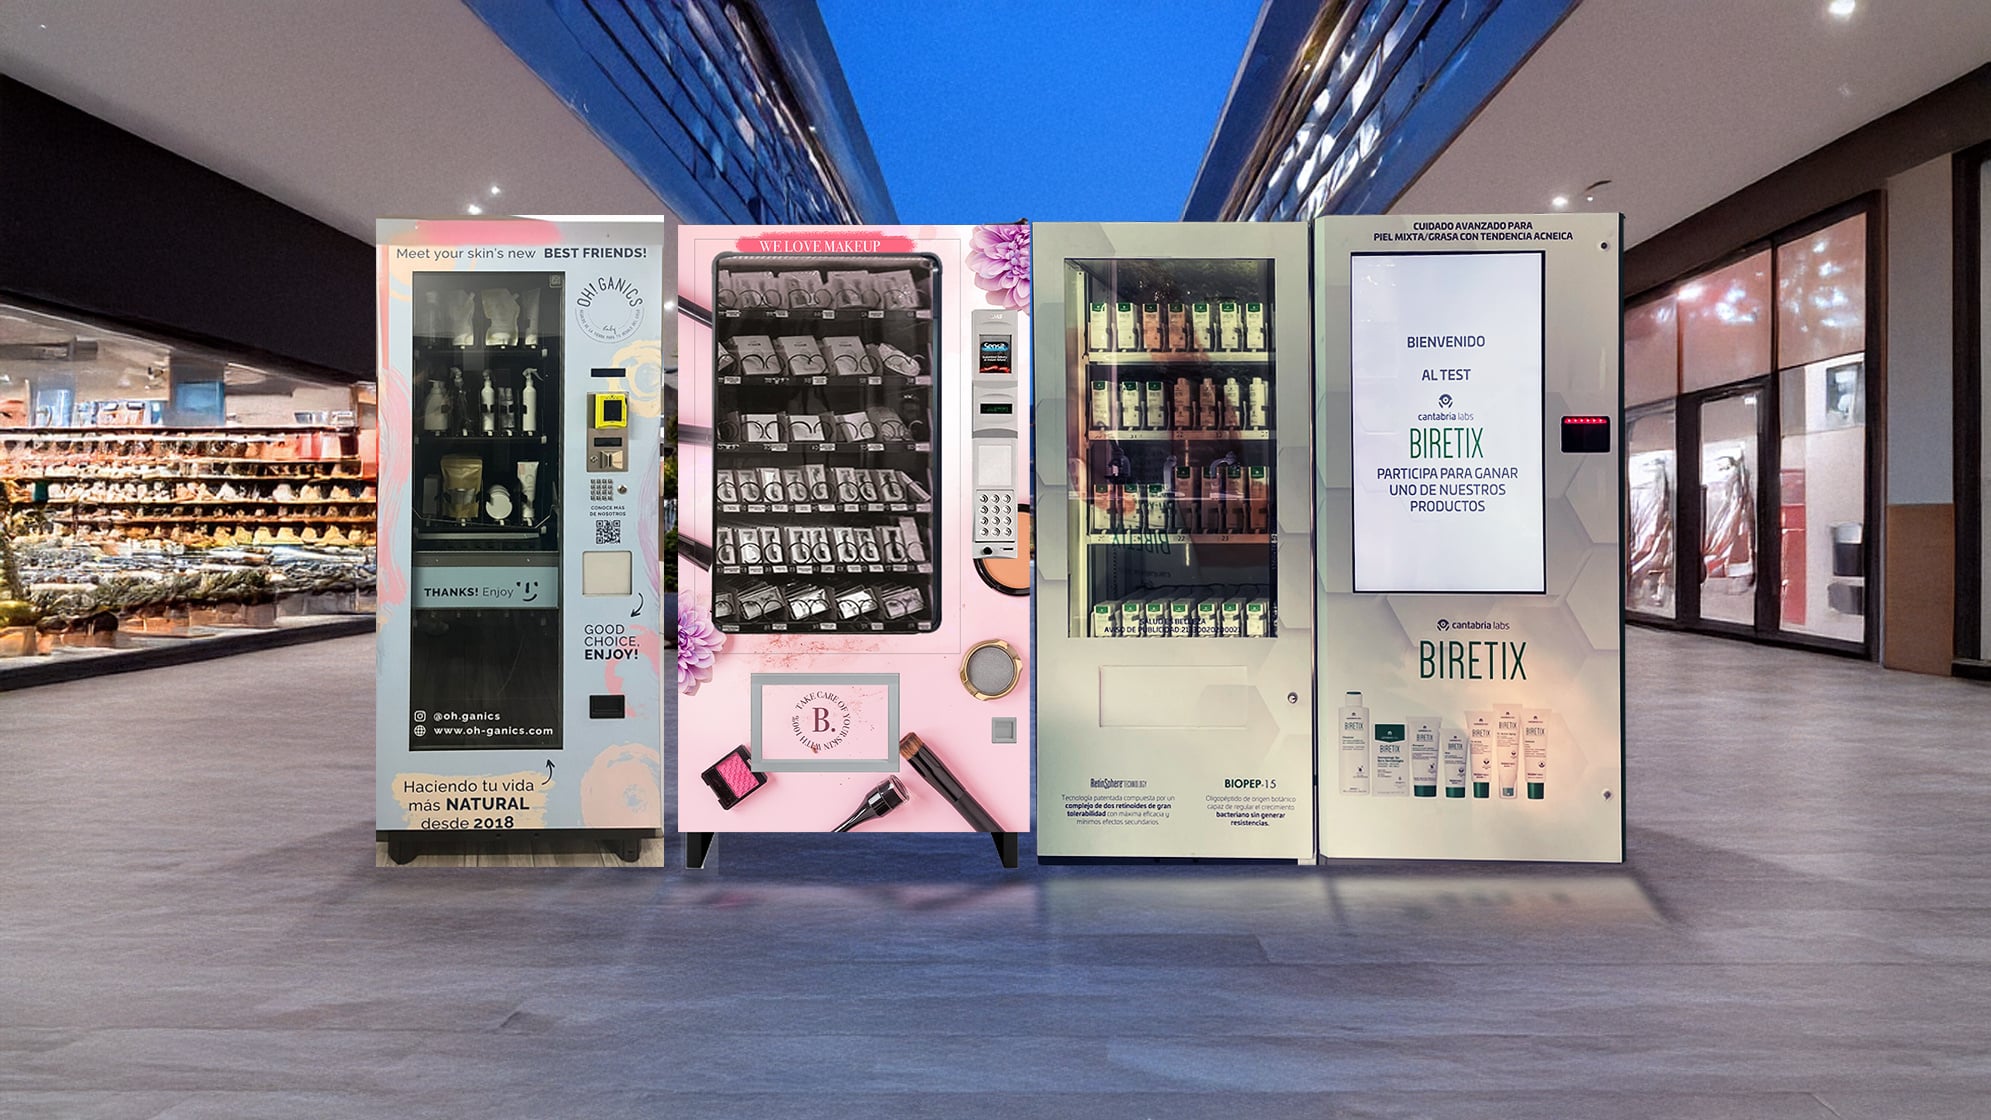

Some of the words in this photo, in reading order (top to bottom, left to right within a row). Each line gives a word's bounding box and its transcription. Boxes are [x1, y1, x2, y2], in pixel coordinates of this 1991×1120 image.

[1413, 222, 1454, 231] CUIDADO
[1455, 221, 1507, 231] AVANZADO
[1508, 221, 1533, 230] PARA
[1373, 233, 1393, 242] PIEL
[1394, 232, 1459, 242] MIXTA/GRASA
[1460, 232, 1480, 241] CON
[1480, 232, 1532, 241] TENDENCIA
[1533, 231, 1573, 241] ACNEICA
[759, 240, 782, 252] WE
[784, 240, 822, 252] LOVE
[824, 240, 881, 252] MAKEUP
[396, 248, 431, 259] Meet
[434, 250, 464, 261] your
[467, 247, 504, 259] skin's
[508, 250, 536, 259] new
[544, 248, 579, 259] BEST
[583, 248, 648, 259] FRIENDS!
[577, 282, 598, 307] OH!
[598, 276, 643, 307] GANICS
[1407, 335, 1486, 349] BIENVENIDO
[1421, 369, 1438, 381] AL
[1440, 369, 1471, 381] TEST
[1418, 412, 1456, 421] cantabria
[1457, 411, 1474, 421] labs
[1410, 427, 1484, 459] BIRETIX
[1377, 468, 1438, 480] PARTICIPA
[1440, 468, 1473, 480] PARA
[1474, 467, 1518, 479] GANAR
[1389, 484, 1417, 496] UNO
[1420, 484, 1437, 496] DE
[1439, 484, 1506, 496] NUESTROS
[1410, 500, 1486, 512] PRODUCTOS
[424, 587, 479, 597] THANKS!
[482, 586, 514, 600] Enjoy
[584, 624, 625, 635] GOOD
[1451, 620, 1492, 630] cantabria
[1493, 620, 1510, 630] labs
[585, 648, 638, 660] ENJOY!
[1419, 640, 1527, 680] BIRETIX
[795, 692, 816, 710] TAKE
[817, 691, 838, 702] CARE
[838, 701, 848, 712] OF
[433, 711, 501, 723] @oh.ganics
[812, 707, 836, 732] B.
[434, 725, 554, 737] www.oh-ganics.com
[840, 713, 851, 738] YOUR
[823, 736, 843, 750] SKIN
[404, 779, 478, 793] Haciendo
[482, 781, 498, 792] tu
[502, 779, 535, 792] vida
[409, 799, 441, 811] más
[446, 797, 530, 811] NATURAL
[421, 817, 469, 829] desde
[473, 816, 514, 829] 2018
